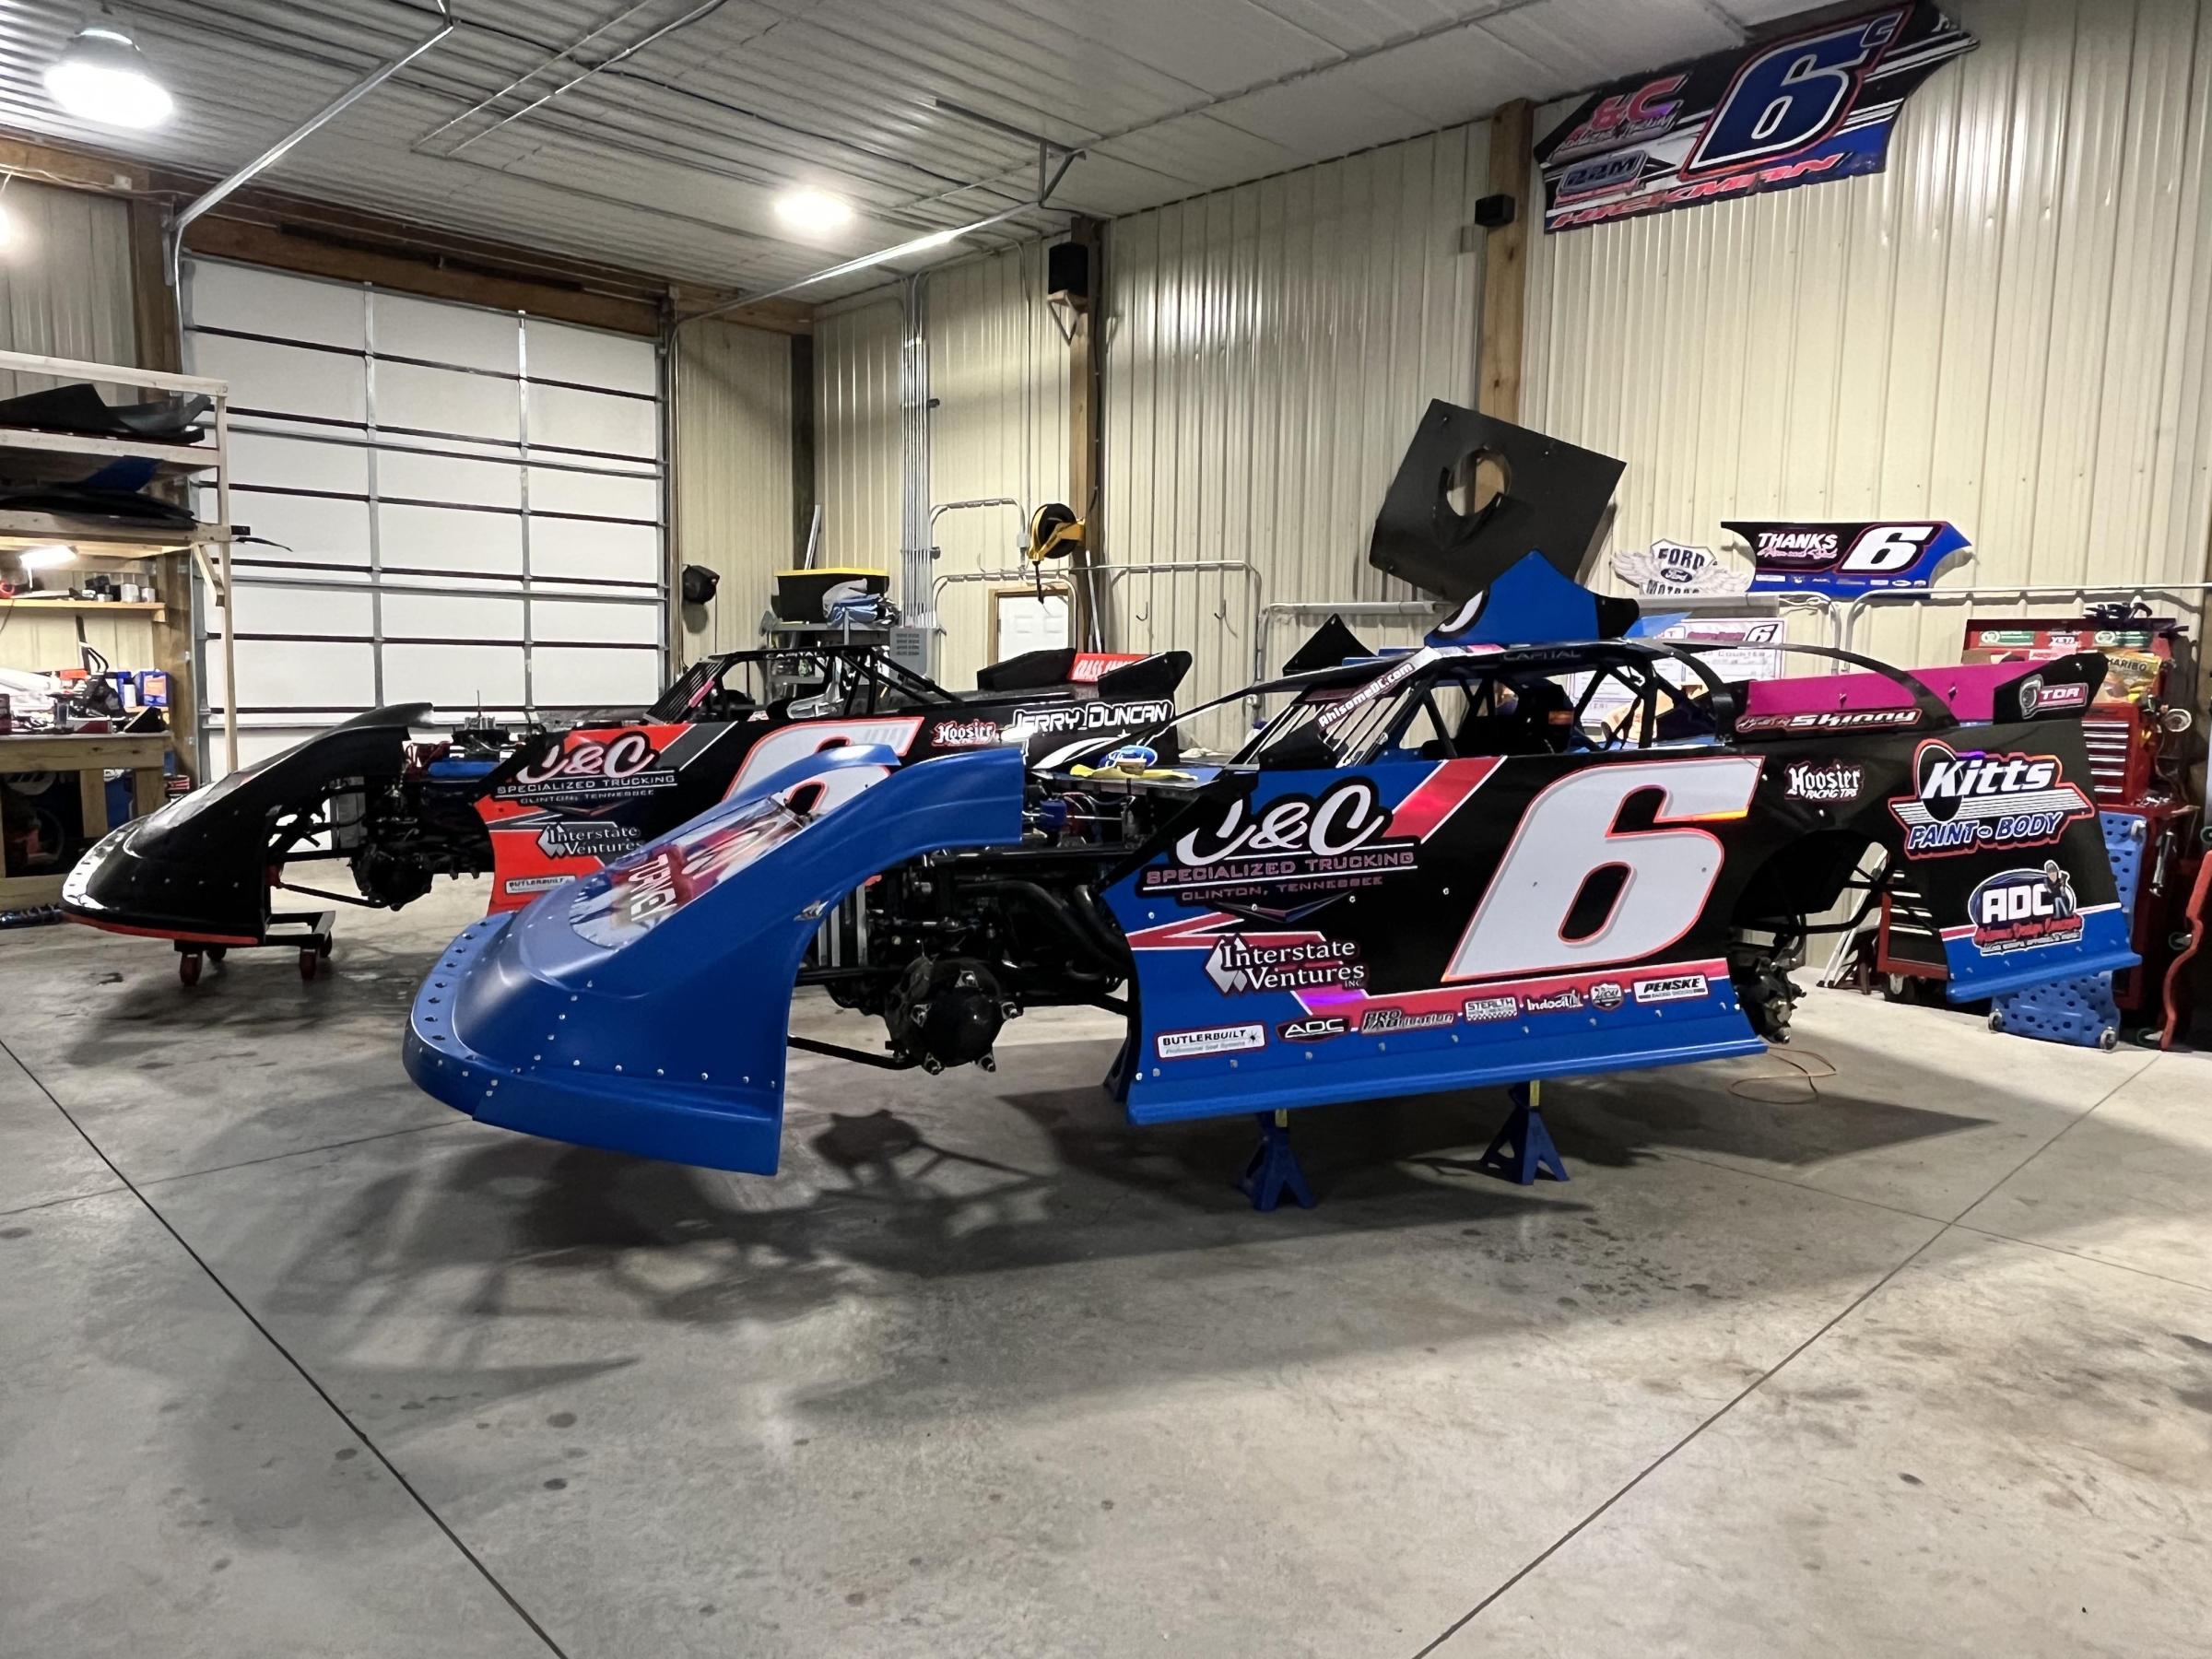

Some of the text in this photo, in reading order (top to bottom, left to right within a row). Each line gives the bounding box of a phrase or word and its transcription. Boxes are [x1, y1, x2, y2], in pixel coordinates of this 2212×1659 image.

[1689, 23, 1875, 171] 6
[1658, 548, 1706, 570] FORD
[1758, 526, 1934, 571] THANKS 6
[1014, 700, 1170, 733] JERRY DUNCAN
[1790, 711, 1919, 728] Skinny
[933, 722, 993, 744] Hoosier
[516, 735, 655, 783] J&C
[497, 775, 676, 794] SPECIALIZED TRUCKING
[1786, 763, 1861, 795] Hoosier
[1920, 759, 2055, 800] Kitts
[584, 789, 654, 800] TENNESSEE
[548, 827, 640, 843] Interstate
[1176, 784, 1384, 865] J&C
[1146, 851, 1415, 885] SPECIALIZED TRUCKING
[1440, 755, 1766, 983] 6
[1182, 877, 1383, 901] CLINTON, TENNESSEE
[1982, 884, 2055, 924] ADC
[1223, 940, 1357, 968] Interstate
[1244, 962, 1365, 990] Ventures
[1643, 977, 1700, 993] PENSKE
[1467, 998, 1513, 1011] STEALTH
[1162, 1030, 1246, 1046] BUTLERBUILT
[1285, 1018, 1345, 1039] ADC
